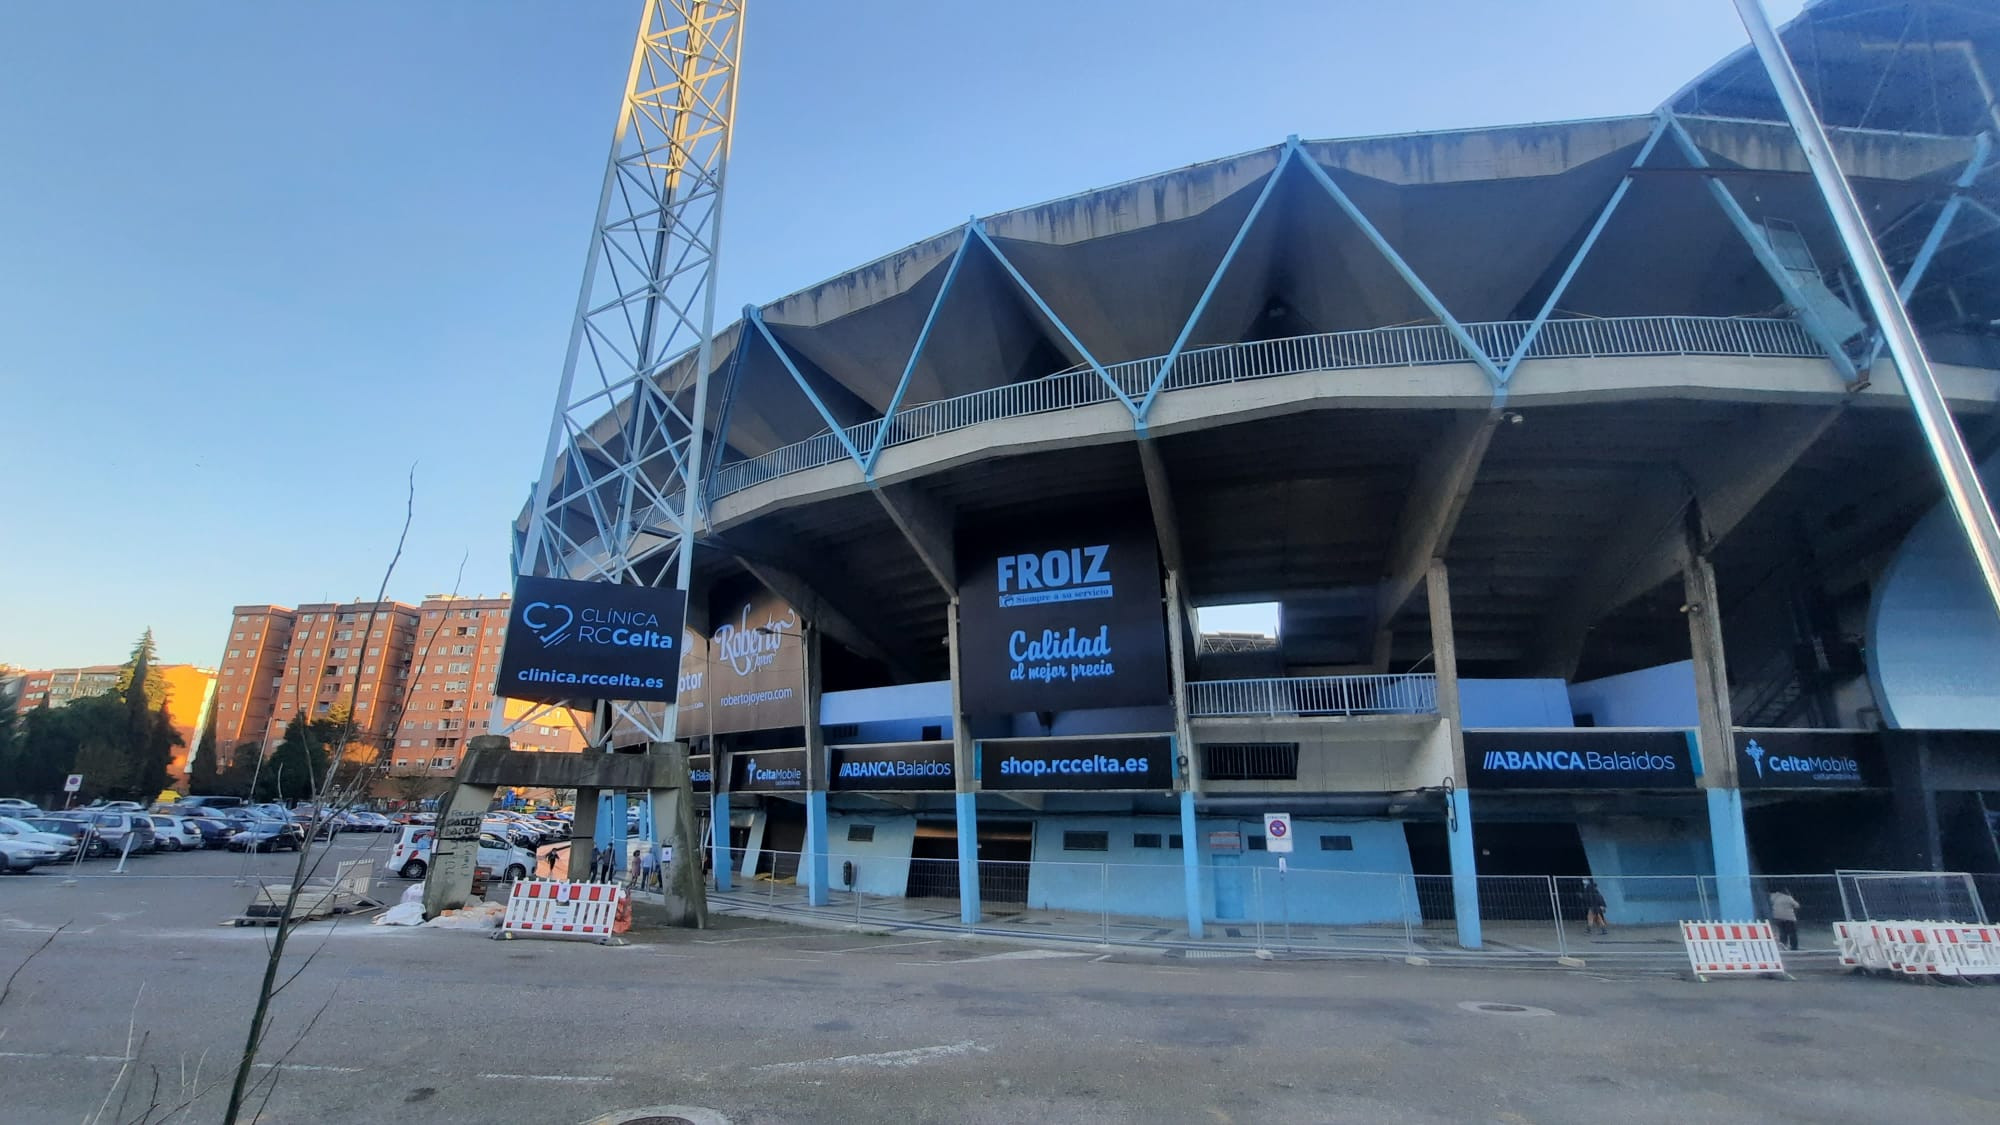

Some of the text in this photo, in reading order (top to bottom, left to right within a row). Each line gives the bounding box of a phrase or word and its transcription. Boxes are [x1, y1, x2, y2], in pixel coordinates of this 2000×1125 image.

[997, 544, 1111, 592] FROIZ
[1016, 593, 1051, 603] Siempre
[1074, 588, 1109, 597] servicio
[581, 607, 659, 628] CLÍNICA
[578, 626, 673, 649] RCCelta
[713, 603, 796, 677] Roberto
[1009, 624, 1112, 662] Calidad
[518, 669, 664, 688] clinica.rccelta.es
[1010, 660, 1115, 683] al mejor precio
[720, 687, 793, 707] robertojoyero.com
[896, 760, 951, 776] Balaídos
[1000, 754, 1149, 776] shop.rccelta.es
[1586, 751, 1675, 770] Balaídos
[1768, 755, 1858, 772] CeltaMobile
[755, 767, 801, 781] CeltaMobile
